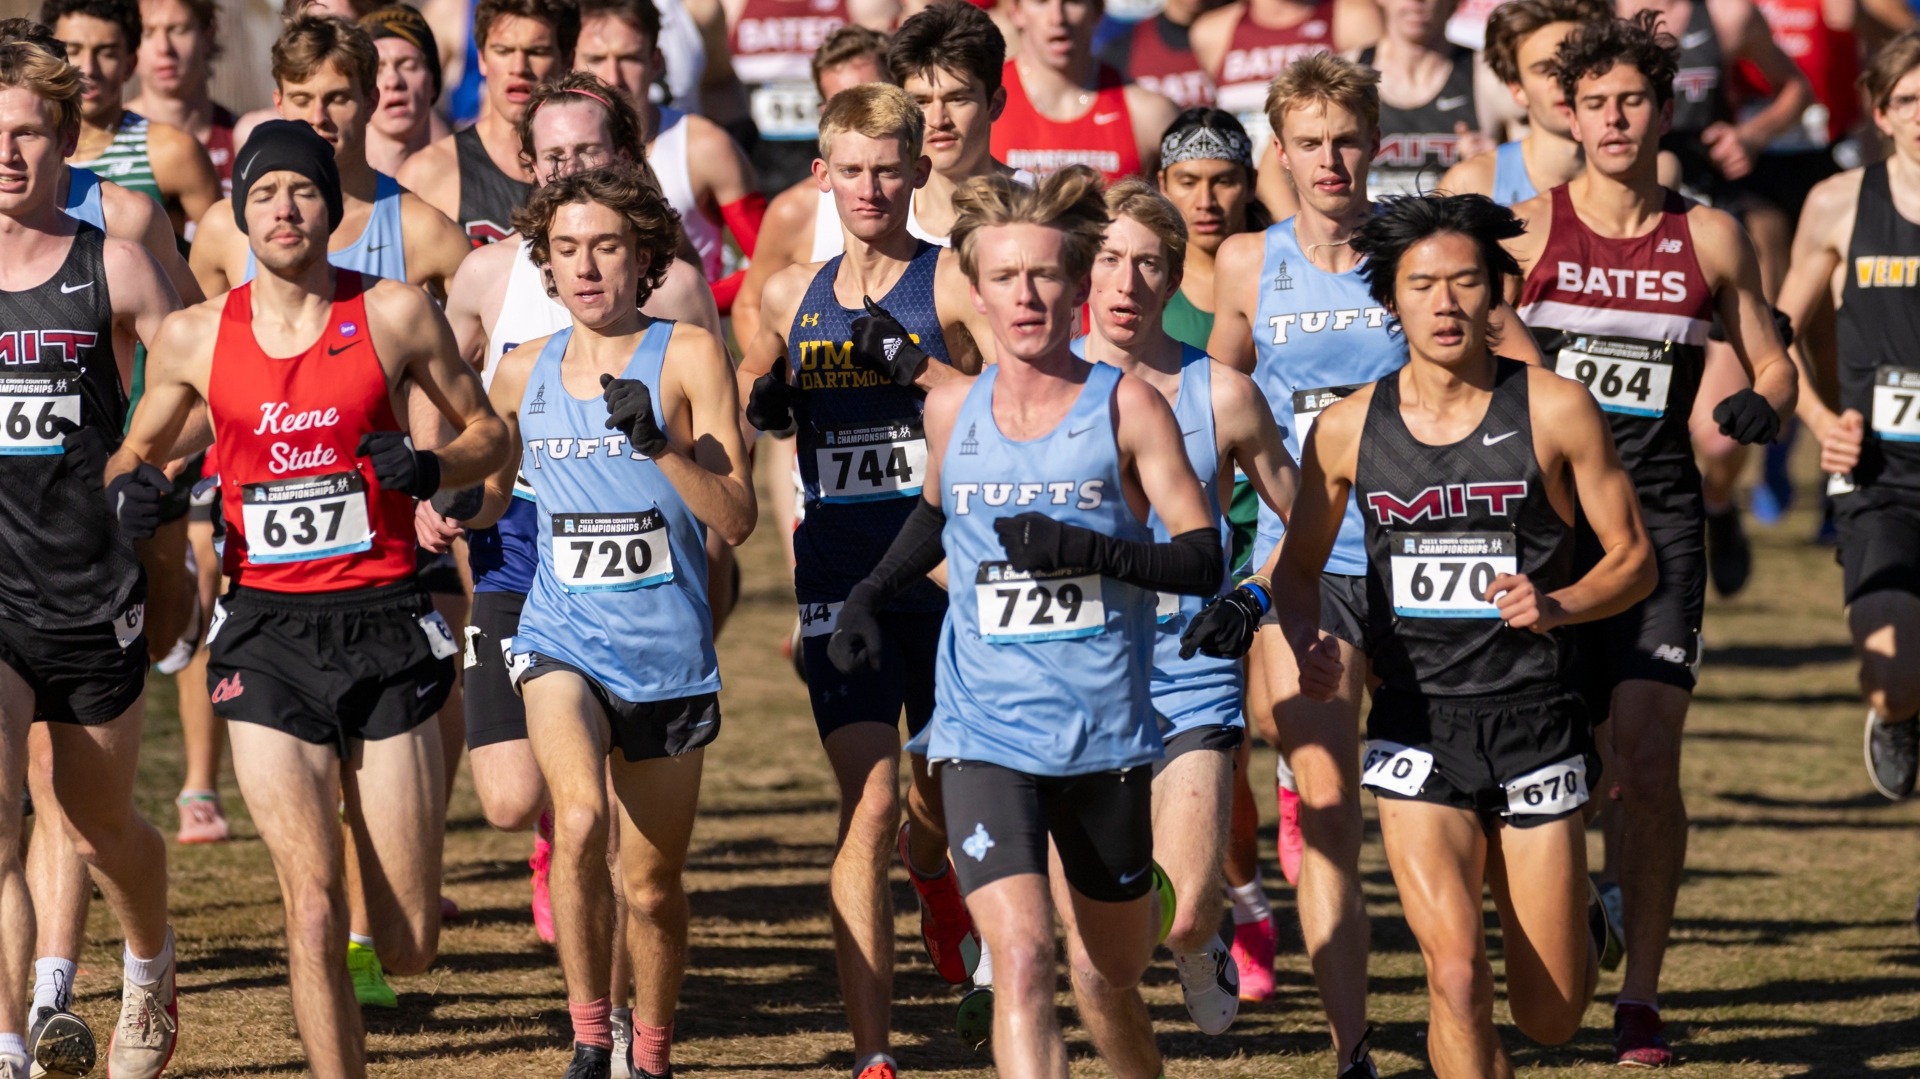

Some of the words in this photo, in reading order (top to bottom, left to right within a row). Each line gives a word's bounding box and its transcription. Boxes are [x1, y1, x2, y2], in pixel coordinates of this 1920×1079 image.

[1556, 261, 1687, 303] BATES
[1575, 360, 1652, 401] 964
[253, 402, 340, 435] Keene
[853, 426, 870, 434] CROSS
[870, 424, 894, 432] COUNTRY
[837, 431, 898, 444] CHAMPIONSHIPS
[268, 442, 338, 474] State
[832, 447, 912, 490] 744
[268, 485, 335, 501] CHAMPIONSHIPS
[951, 479, 1105, 516] TUFTS
[1366, 480, 1528, 525] MIT
[263, 501, 347, 548] 637
[577, 523, 640, 533] CHAMPIONSHIPS
[570, 538, 653, 579] 720
[1418, 544, 1489, 554] CHAMPIONSHIPS
[1410, 562, 1496, 603] 670
[996, 583, 1084, 628] 729
[1364, 749, 1413, 780] 670
[1523, 770, 1578, 806] 670
